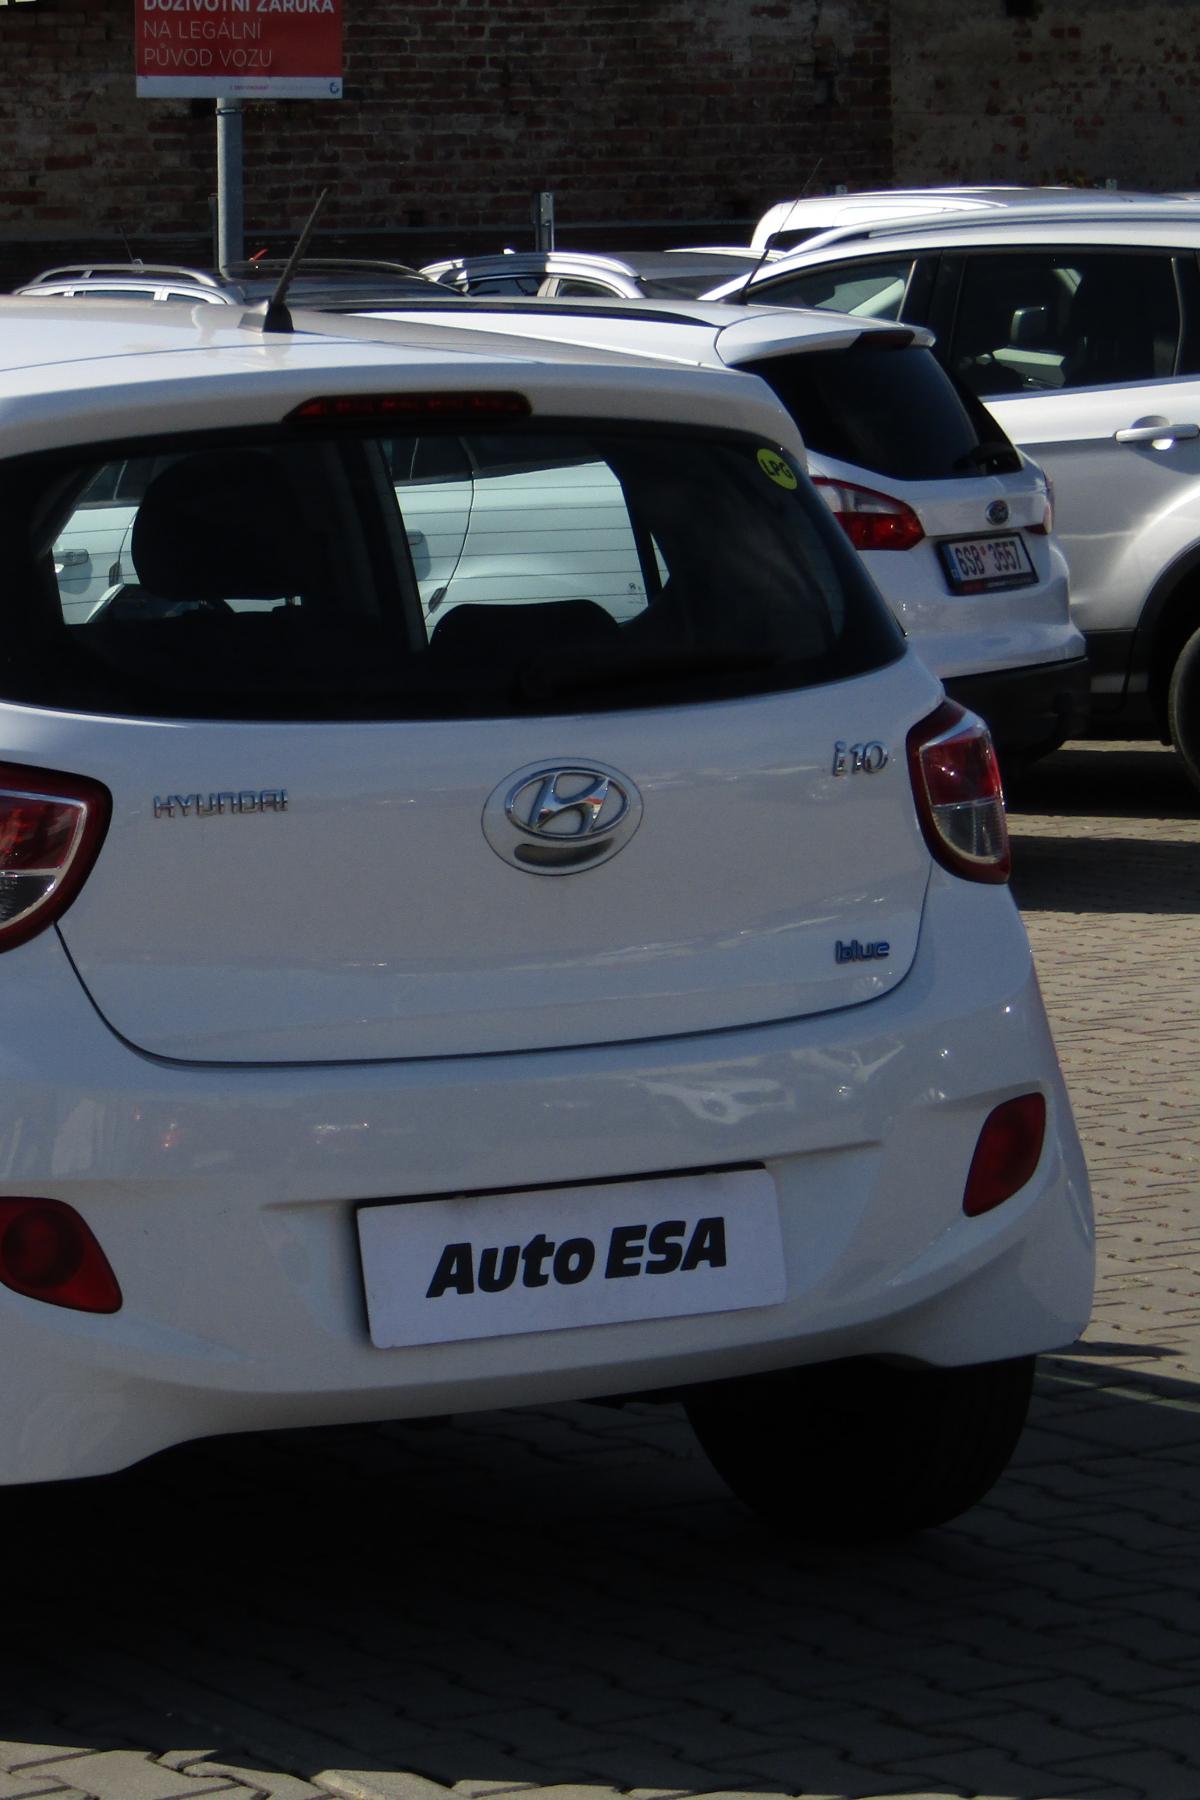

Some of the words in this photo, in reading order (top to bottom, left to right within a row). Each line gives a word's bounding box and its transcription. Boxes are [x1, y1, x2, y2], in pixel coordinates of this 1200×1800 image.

[143, 20, 172, 39] NA
[178, 16, 262, 40] LEGÁLNÍ
[143, 43, 213, 67] PŮVOD
[220, 49, 273, 68] VOZU
[759, 457, 794, 480] LPG
[832, 740, 889, 777] i10
[153, 788, 288, 819] HYUNDAI
[834, 940, 890, 965] blue
[425, 1233, 596, 1299] Auto
[604, 1216, 727, 1280] ESA
